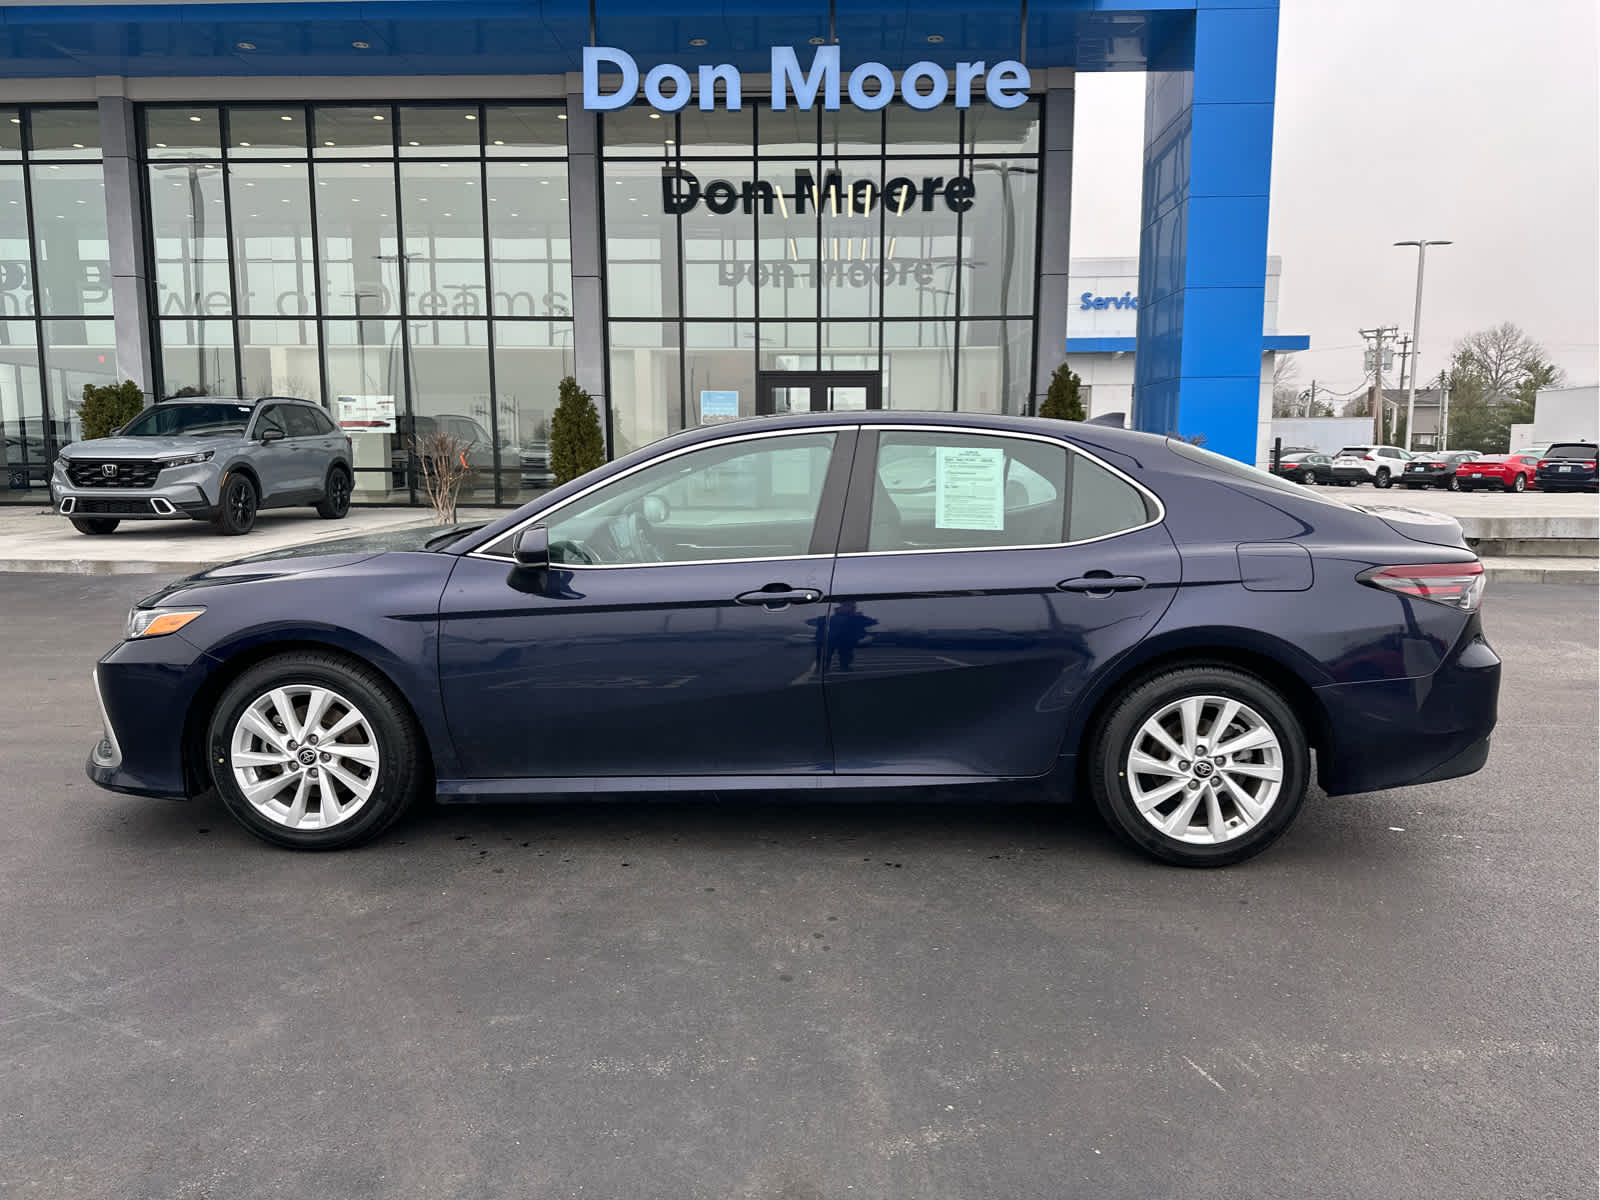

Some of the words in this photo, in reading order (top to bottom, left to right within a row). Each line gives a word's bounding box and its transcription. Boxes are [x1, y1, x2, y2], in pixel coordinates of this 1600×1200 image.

[583, 46, 742, 112] Don
[771, 45, 1032, 112] Moore
[662, 167, 774, 215] Don
[795, 167, 975, 215] Moore
[80, 286, 255, 315] Pwer
[1080, 291, 1138, 310] Servic
